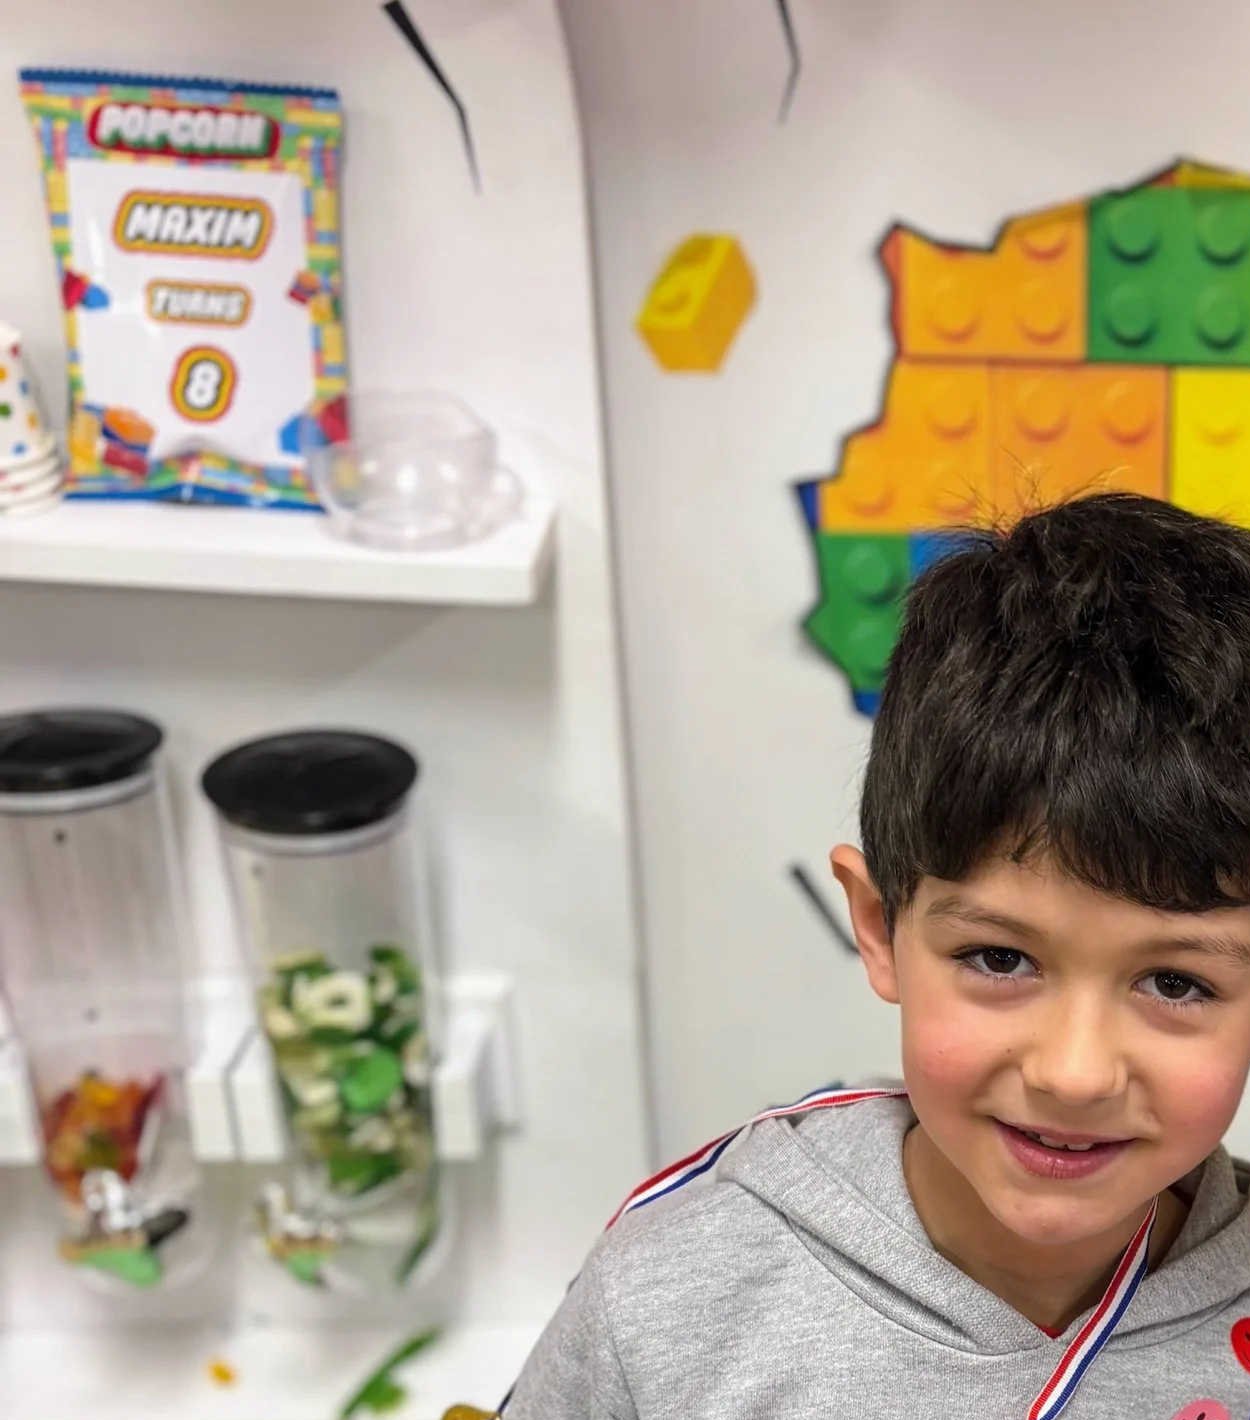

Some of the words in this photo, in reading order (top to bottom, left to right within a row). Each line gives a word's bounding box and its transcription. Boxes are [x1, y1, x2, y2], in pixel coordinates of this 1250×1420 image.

[97, 104, 269, 153] POPCORN
[124, 201, 262, 251] MAXIM
[151, 286, 247, 322] TURNS
[184, 362, 221, 410] 8
